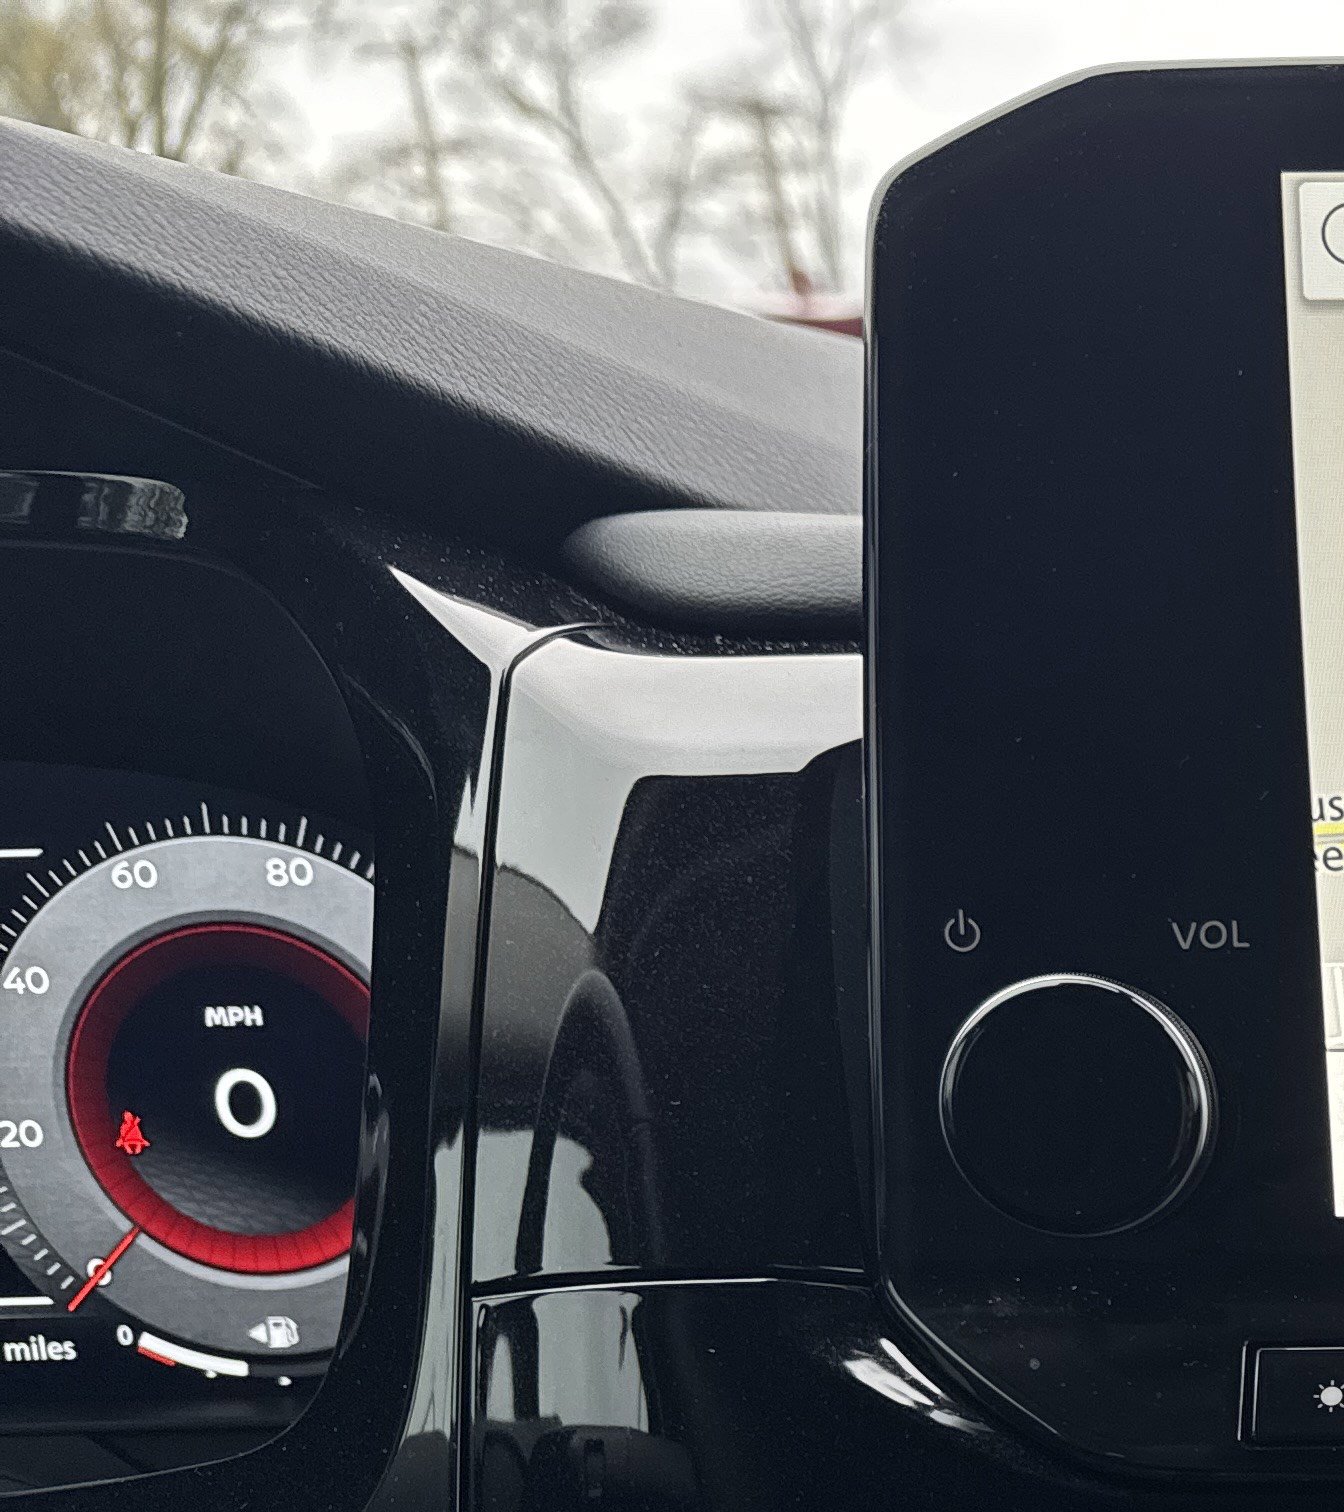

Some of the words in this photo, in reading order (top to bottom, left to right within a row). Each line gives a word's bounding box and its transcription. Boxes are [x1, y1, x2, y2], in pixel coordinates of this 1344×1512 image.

[265, 857, 314, 887] 80
[1314, 845, 1344, 872] e
[110, 859, 158, 889] 60
[1171, 919, 1250, 950] VOL
[3, 966, 50, 995] 40
[204, 1005, 264, 1029] MPH
[214, 1068, 277, 1138] 0
[0, 1119, 44, 1149] 20
[3, 1336, 77, 1363] miles
[117, 1325, 132, 1346] 0
